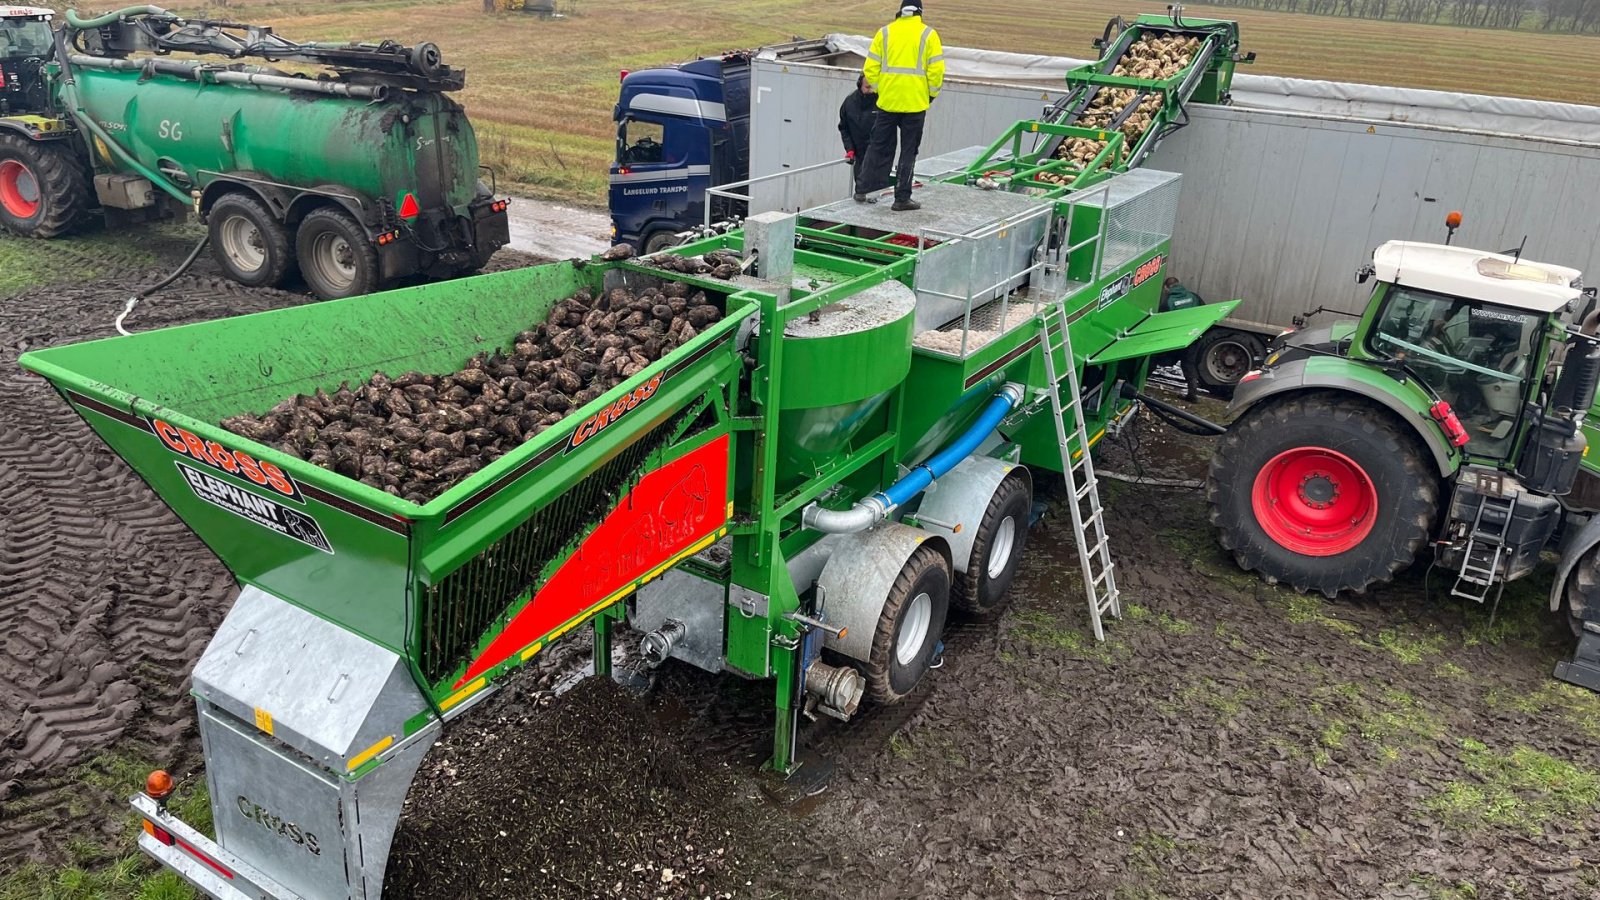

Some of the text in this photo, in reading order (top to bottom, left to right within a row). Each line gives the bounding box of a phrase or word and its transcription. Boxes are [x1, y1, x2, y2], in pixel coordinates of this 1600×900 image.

[158, 119, 183, 141] SG
[660, 185, 688, 194] TRANSPO
[184, 466, 279, 521] ELEPHANT
